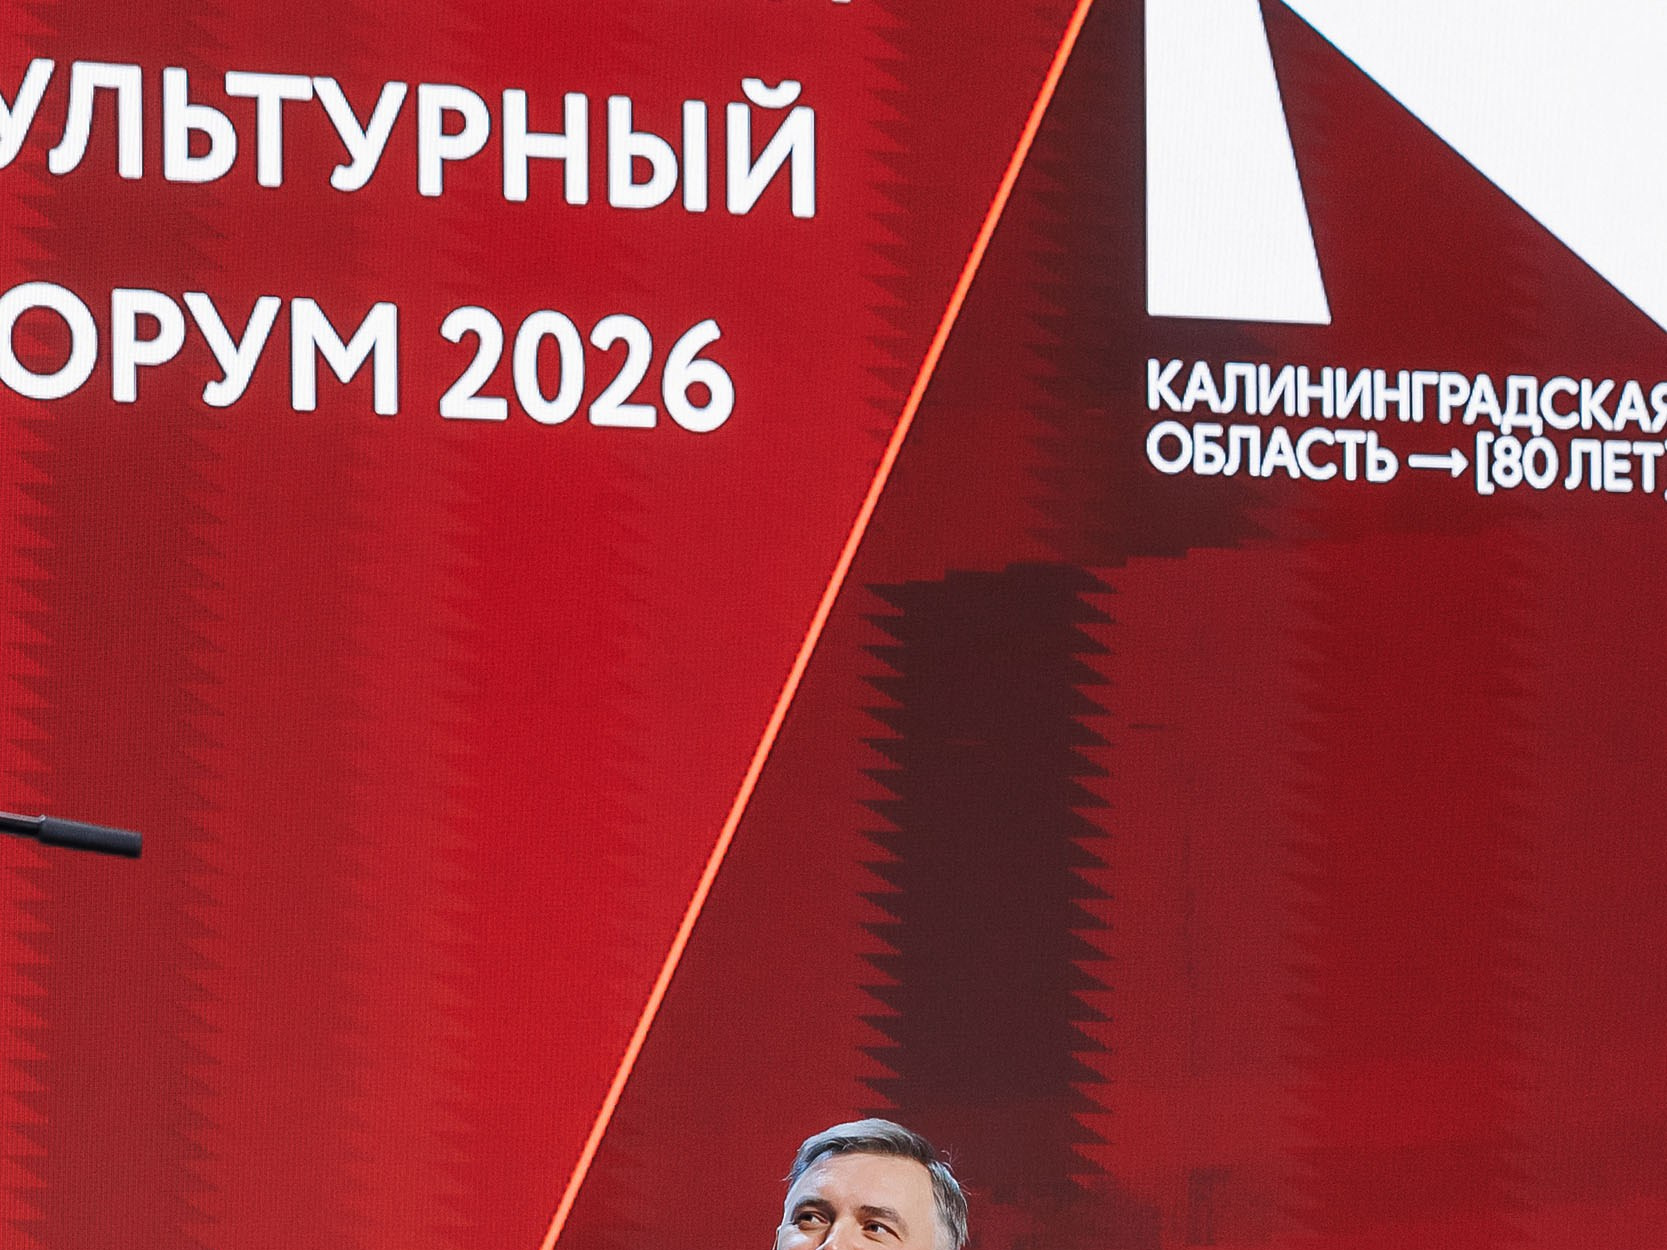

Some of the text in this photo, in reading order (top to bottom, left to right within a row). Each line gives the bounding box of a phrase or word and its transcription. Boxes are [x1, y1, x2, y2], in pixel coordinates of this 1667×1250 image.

[0, 281, 735, 433] ОРУМ 2026
[1146, 420, 1398, 482] ОБЛАСТЬ
[1565, 437, 1667, 500] ЛЕТ
